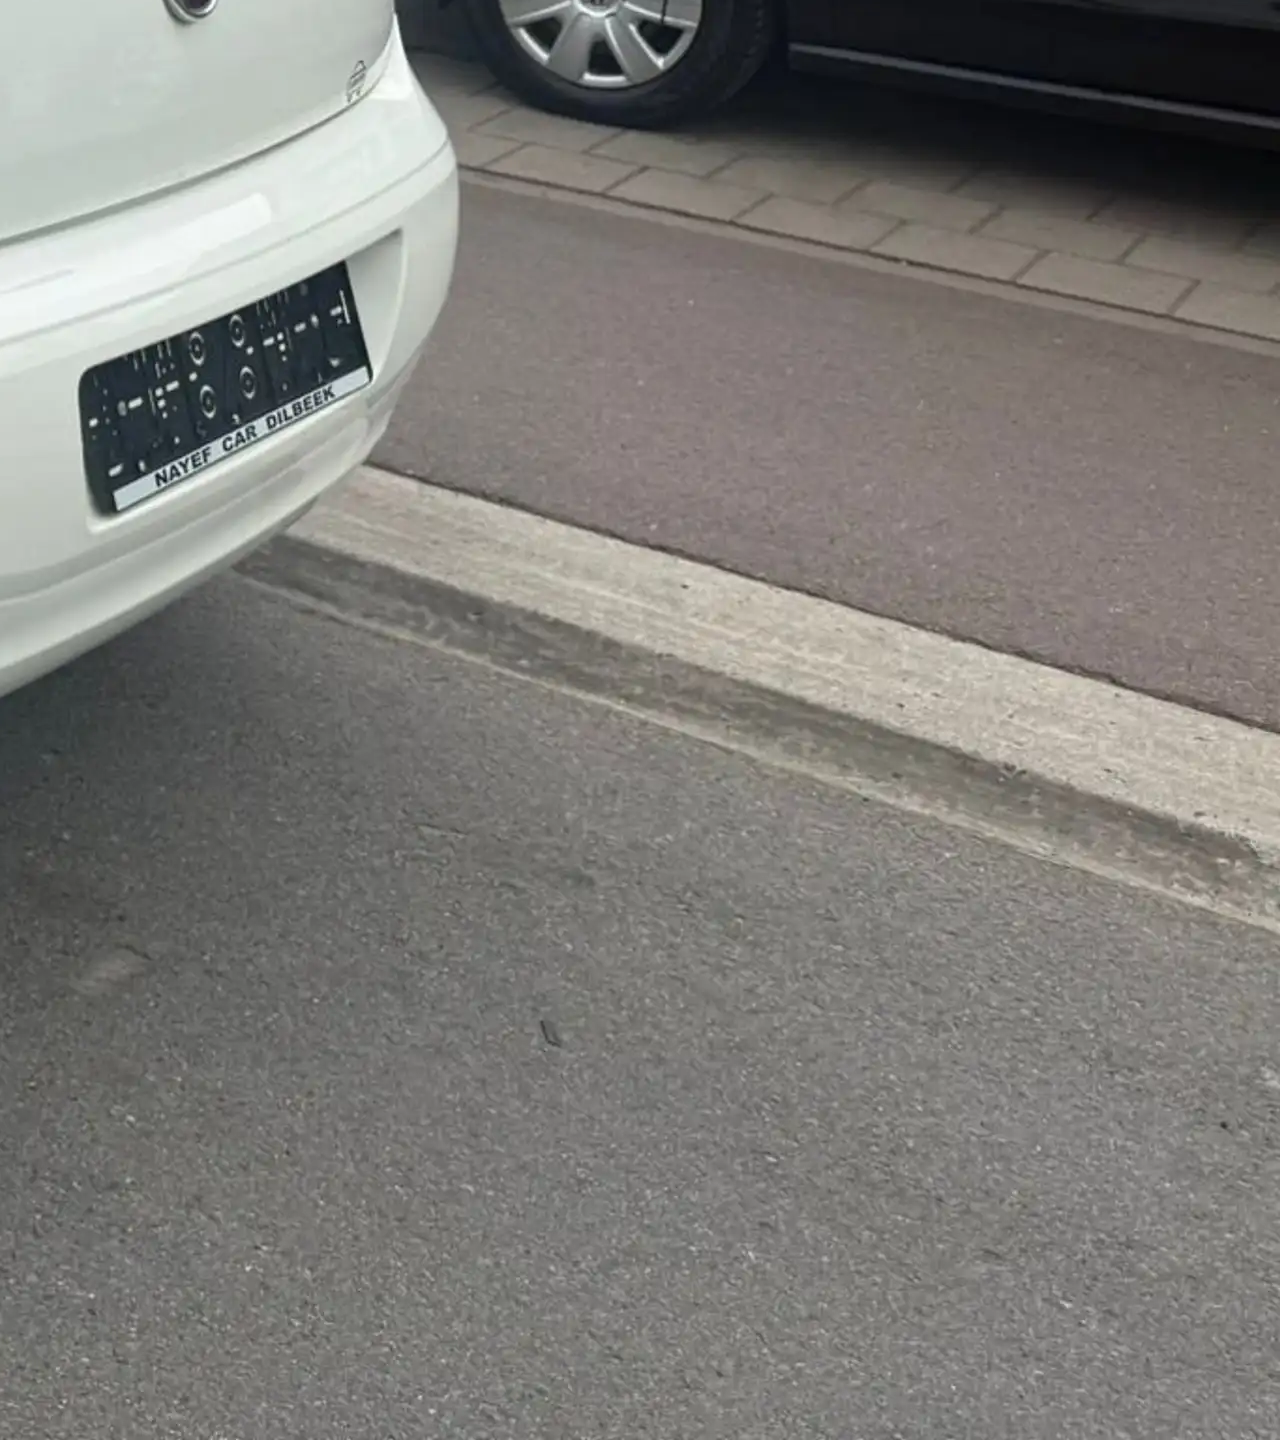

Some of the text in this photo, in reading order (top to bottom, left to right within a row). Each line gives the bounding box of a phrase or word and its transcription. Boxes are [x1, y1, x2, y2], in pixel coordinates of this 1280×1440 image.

[154, 385, 336, 487] NAYEF CAR DILBEEK
